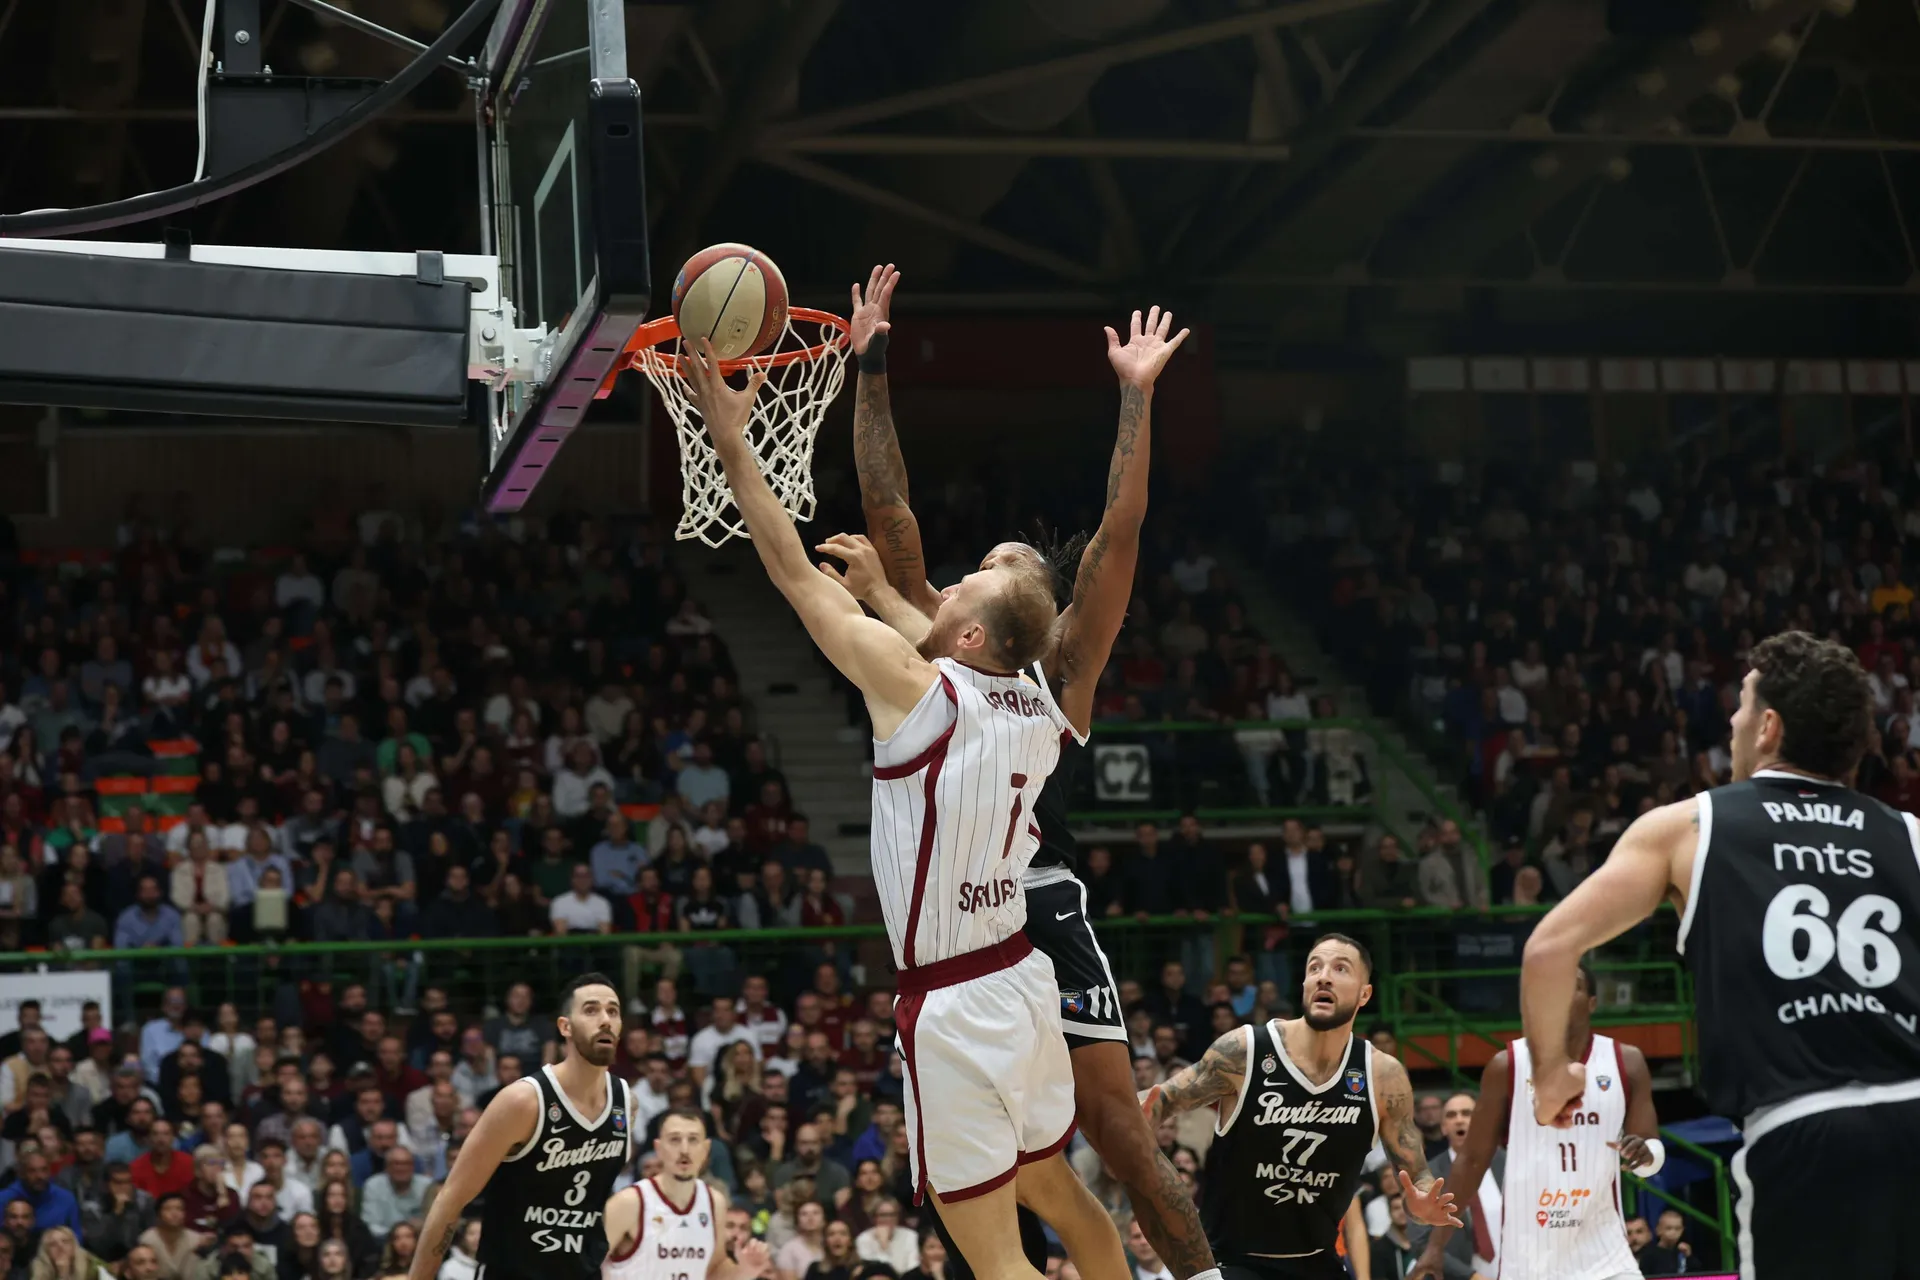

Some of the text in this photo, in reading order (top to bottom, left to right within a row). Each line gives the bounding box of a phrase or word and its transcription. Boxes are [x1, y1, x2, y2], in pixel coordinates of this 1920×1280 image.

[1098, 751, 1152, 796] C2
[1762, 801, 1866, 831] PAJOLA
[1773, 842, 1875, 879] mts
[1762, 883, 1902, 989] 66
[1086, 984, 1113, 1019] 11
[1253, 1091, 1362, 1126] Partizan
[535, 1137, 625, 1172] Partizan
[1282, 1127, 1329, 1166] 77
[1558, 1142, 1577, 1172] 11
[564, 1170, 592, 1207] 3
